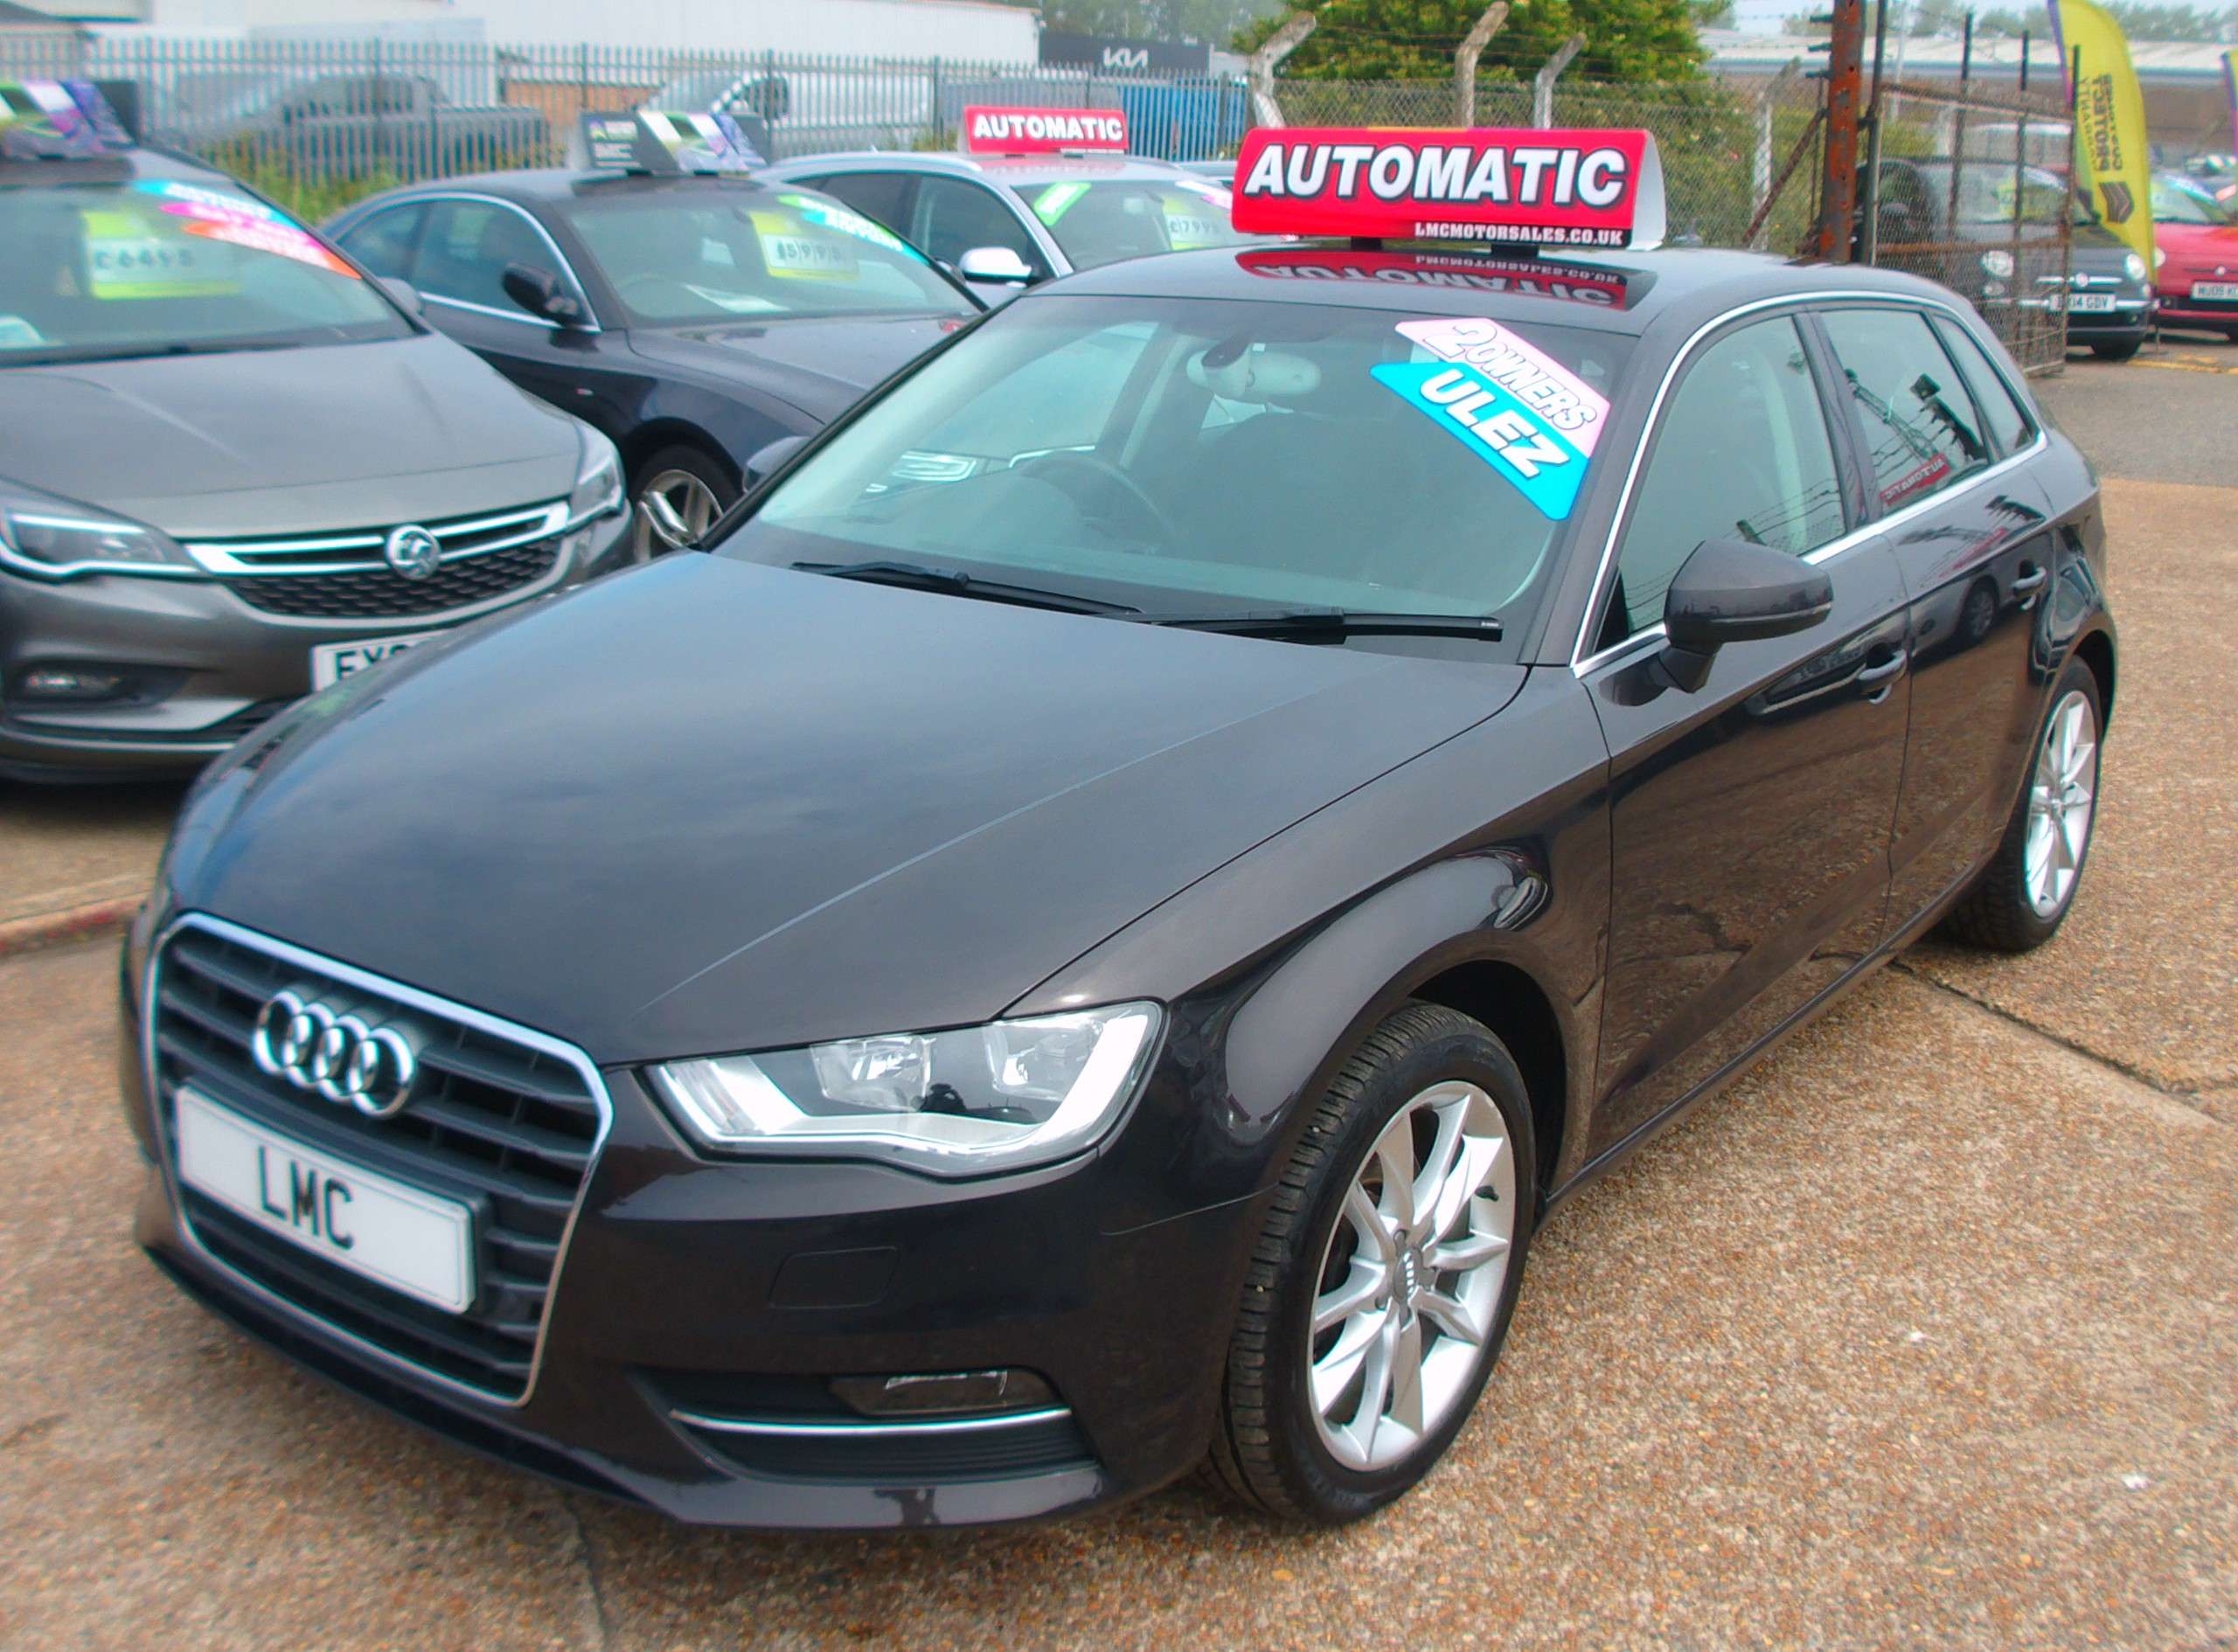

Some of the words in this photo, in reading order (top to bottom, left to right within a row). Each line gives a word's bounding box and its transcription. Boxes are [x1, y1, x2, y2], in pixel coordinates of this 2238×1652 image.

[973, 115, 1124, 142] AUTOMATIC
[1242, 144, 1627, 207] AUTOMATIC
[1414, 221, 1623, 246] LMCMOTORSALES.CO.UK
[1420, 367, 1571, 480] ULEZ
[1464, 342, 1598, 431] OWNERS
[257, 1145, 354, 1251] LMC
